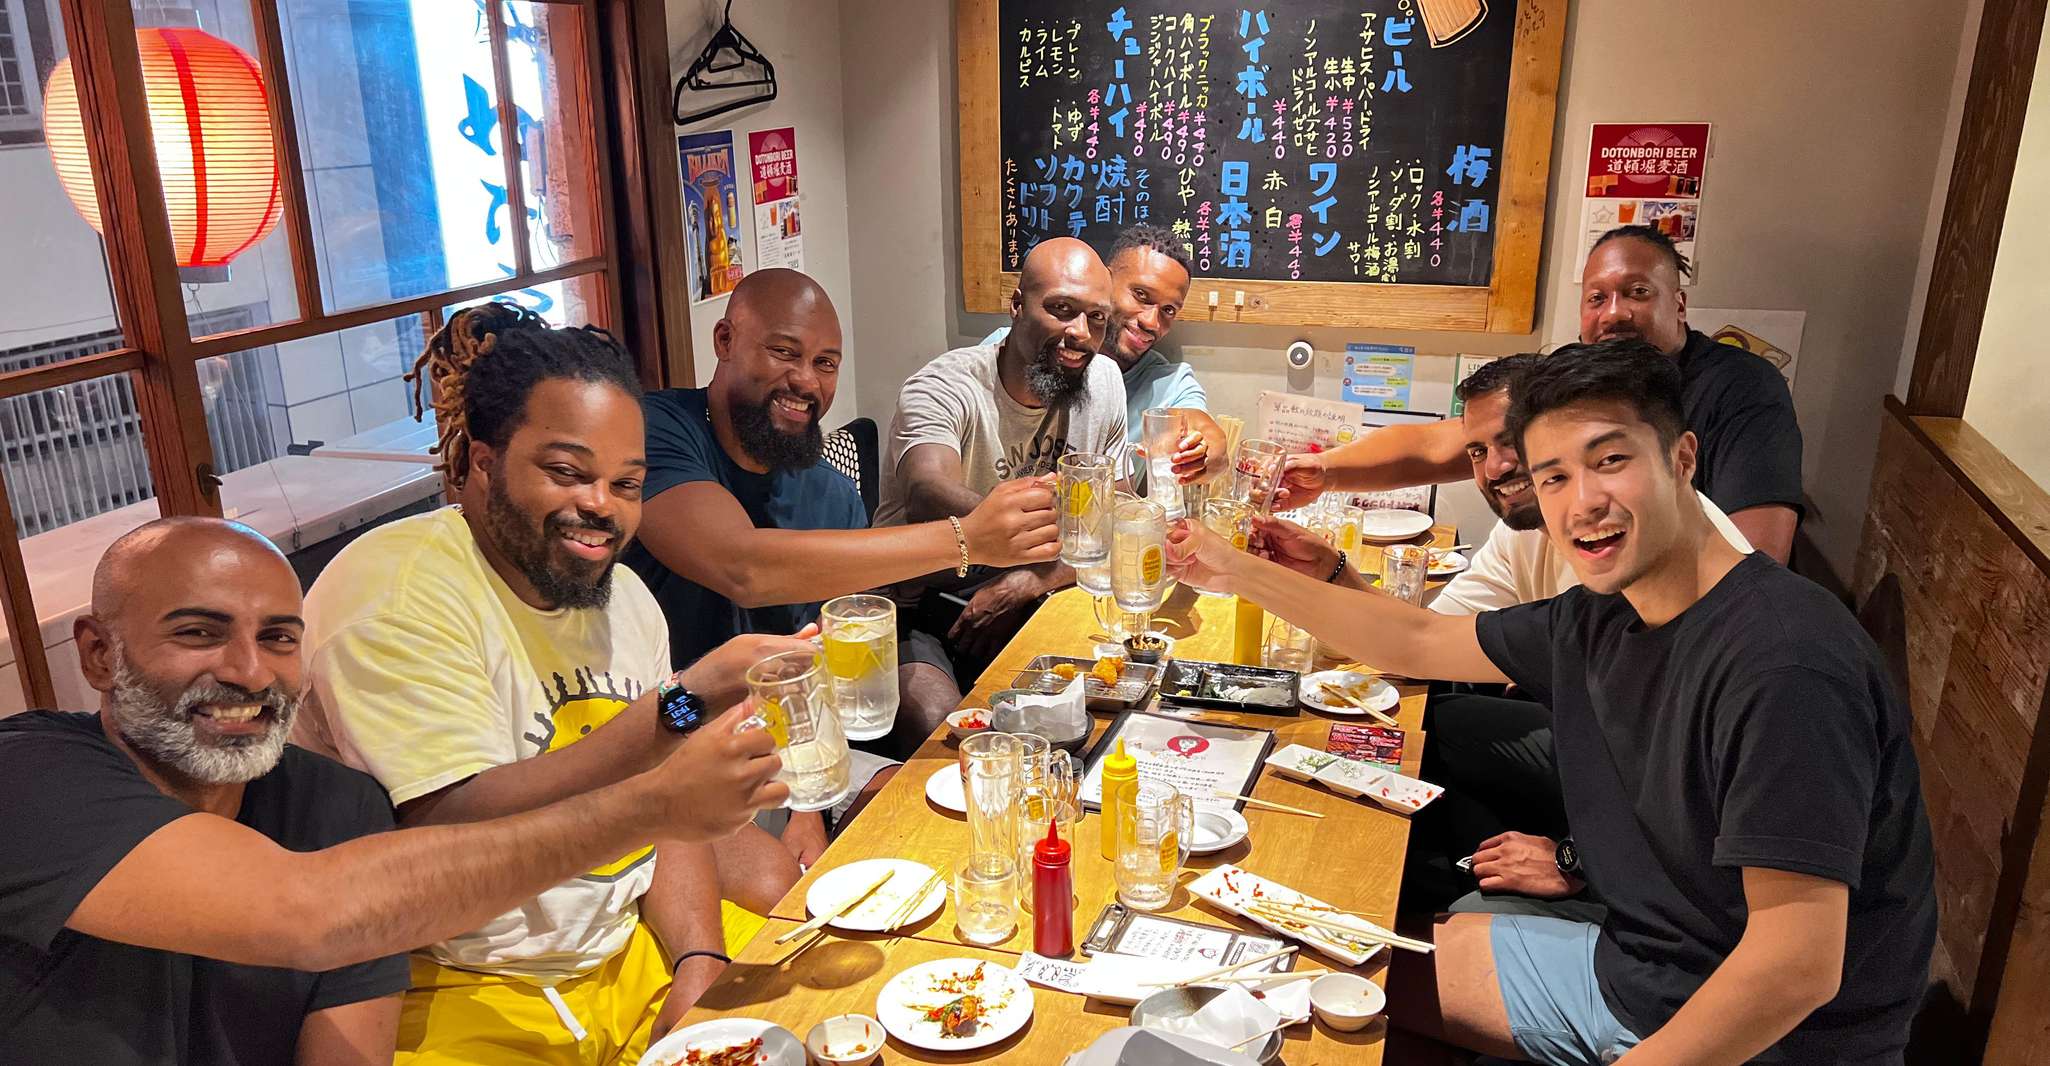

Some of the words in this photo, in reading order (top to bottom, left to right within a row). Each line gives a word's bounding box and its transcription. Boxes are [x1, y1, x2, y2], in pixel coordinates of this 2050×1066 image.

[1019, 27, 1032, 88] カルピス
[1035, 28, 1049, 78] ライム
[1049, 28, 1064, 75] レモン
[1066, 23, 1082, 79] プレーン
[1104, 6, 1143, 140] チューハイ
[1147, 13, 1165, 143] ジンジャーハイボール
[1162, 16, 1177, 97] コークハイ
[1178, 12, 1195, 110] 角ハイボール
[1195, 14, 1215, 109] ブラックニッカ
[1236, 9, 1270, 144] ハイボール
[1302, 19, 1321, 156] ノンアルコールアサヒ
[1323, 56, 1342, 92] 生小
[1338, 55, 1356, 92] 生中
[1358, 12, 1377, 151] アサヒスーパードライ
[1382, 16, 1416, 93] ビール
[1051, 106, 1063, 150] トマト
[1067, 107, 1085, 142] ゆず
[1133, 101, 1148, 157] ¥490
[1160, 99, 1176, 161] ¥490
[1174, 109, 1190, 165] ¥490
[1191, 111, 1207, 167] ¥440
[1271, 97, 1287, 160] ¥440
[1291, 67, 1307, 147] ドライゼロ
[1323, 95, 1339, 159] ¥420
[1342, 98, 1354, 157] ¥520
[1089, 152, 1131, 225] 焼酎
[1446, 144, 1492, 233] 梅酒
[1601, 147, 1664, 158] DOTONBORI
[1666, 148, 1697, 158] BEER
[1005, 158, 1020, 268] たくさんあります
[1020, 182, 1042, 259] ドリン
[1034, 154, 1057, 231] ソフト
[1061, 154, 1087, 238] カクテ
[1215, 160, 1253, 269] 日本酒
[1261, 169, 1289, 229] 赤・白
[1308, 162, 1342, 257] ワイン
[1363, 165, 1381, 277] ノンアルコール梅酒
[1403, 167, 1425, 260] ロック・水割
[1429, 190, 1444, 267] 各¥440
[1195, 200, 1212, 271] 各¥440
[1346, 241, 1361, 275] サワー
